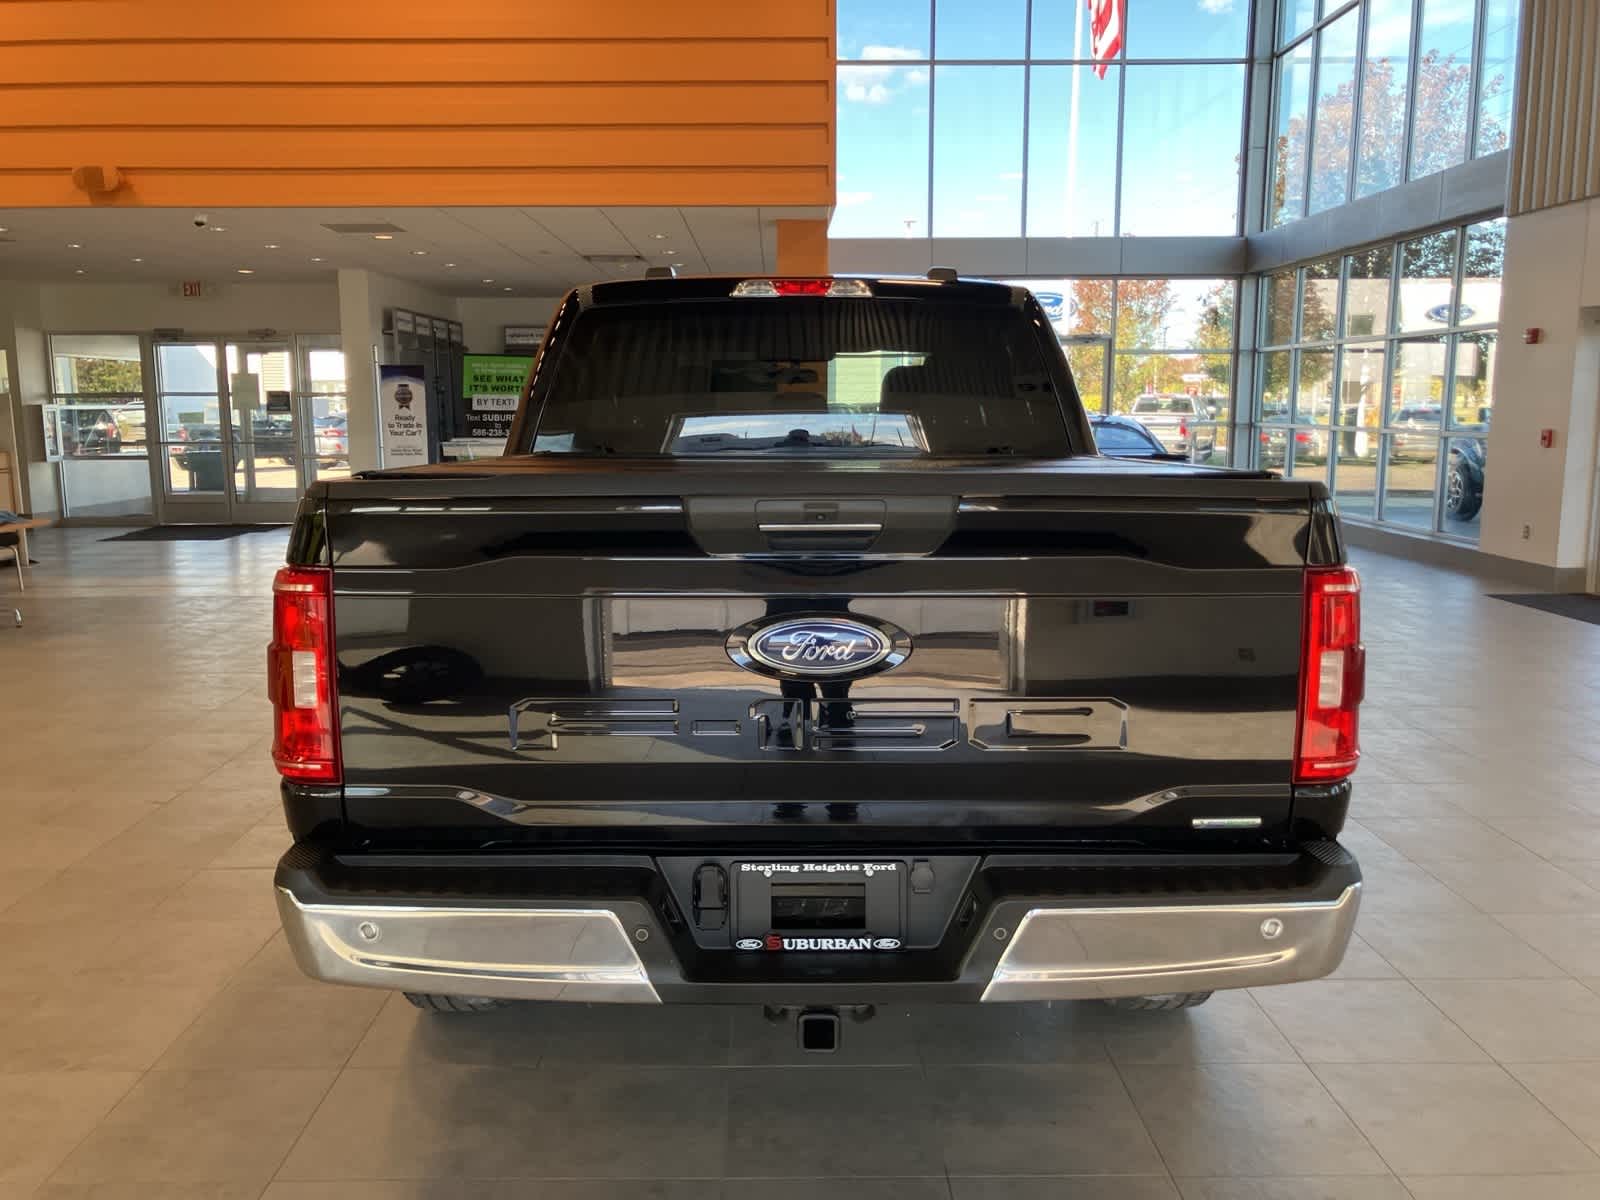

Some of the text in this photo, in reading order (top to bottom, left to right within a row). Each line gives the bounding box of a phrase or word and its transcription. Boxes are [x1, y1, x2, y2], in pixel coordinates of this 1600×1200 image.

[473, 375, 526, 383] SEE WHAT
[469, 384, 488, 392] IT'S
[476, 398, 488, 406] BY
[395, 414, 416, 422] Ready
[781, 630, 857, 661] Ford
[508, 697, 1129, 751] F-150
[741, 863, 897, 873] Sterling Heights Ford
[766, 934, 872, 950] SUBURBAN
